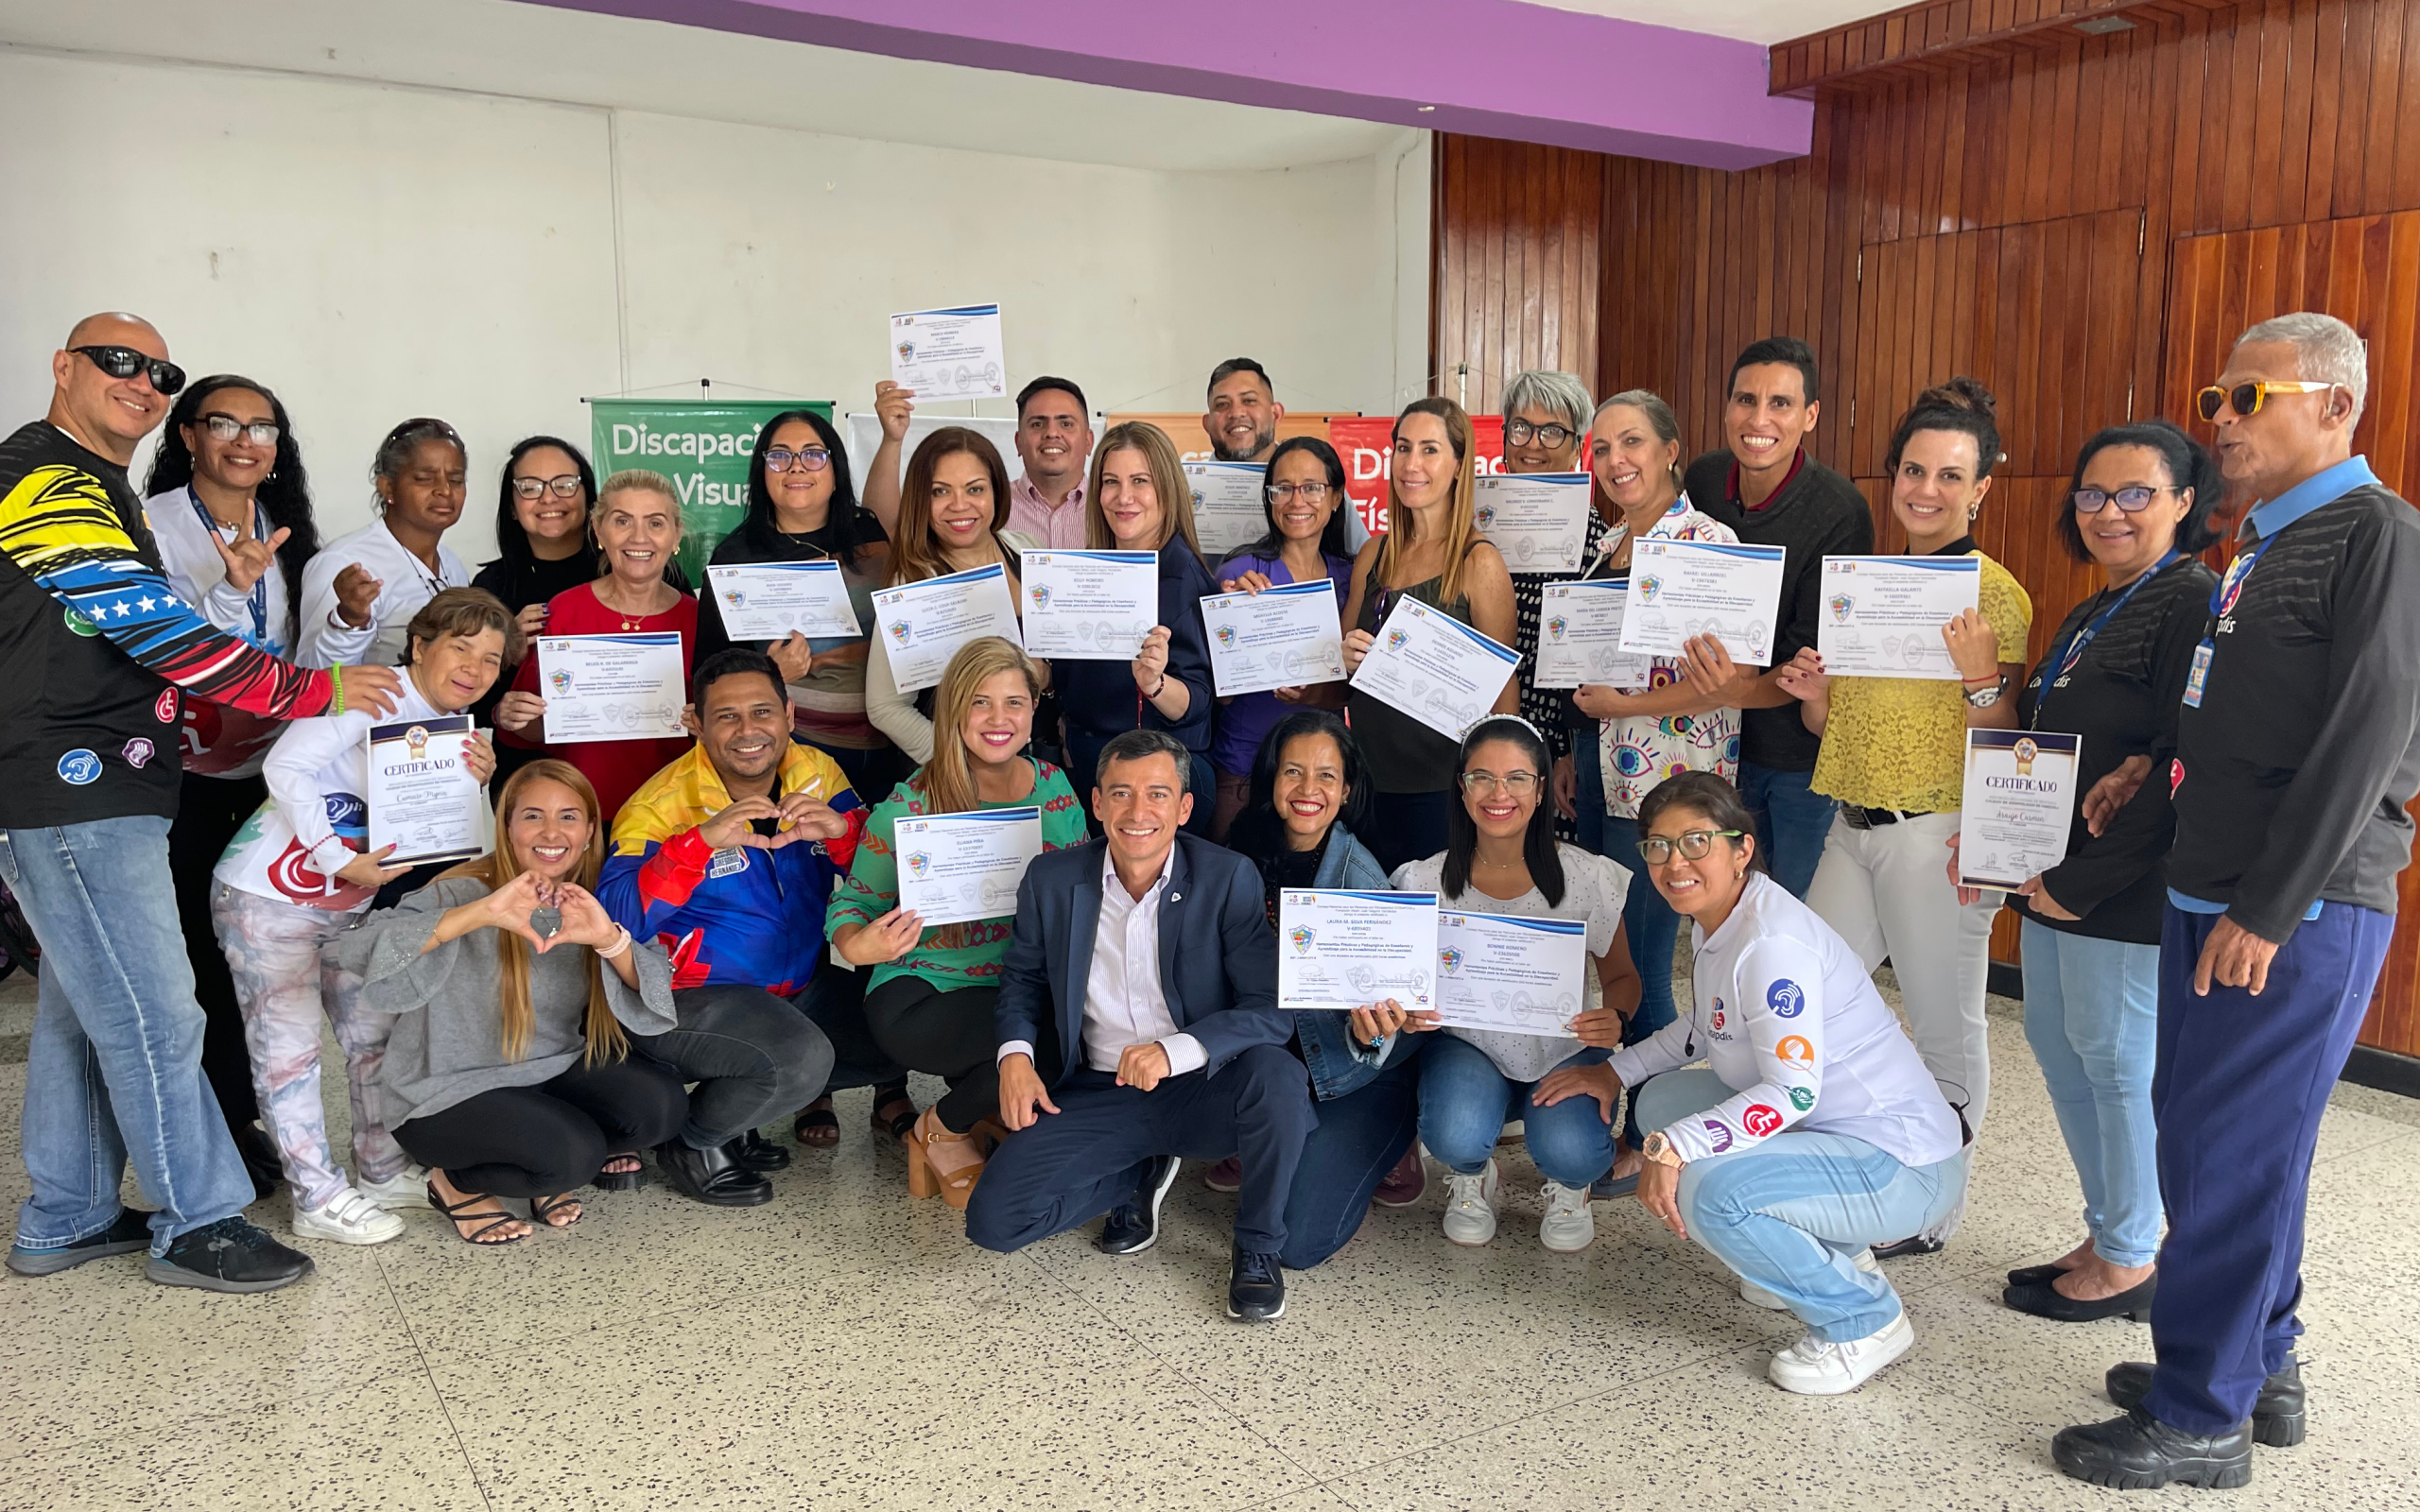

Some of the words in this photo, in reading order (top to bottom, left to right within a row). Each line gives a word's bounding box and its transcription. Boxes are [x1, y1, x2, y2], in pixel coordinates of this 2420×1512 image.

[613, 422, 762, 464] Discapaci
[673, 472, 751, 507] Visua
[1351, 496, 1389, 531] Fís
[2215, 615, 2237, 637] pdis
[2029, 675, 2071, 688] Codis
[384, 758, 455, 776] CERTIFICADO
[1985, 776, 2058, 793] CERTIFICADO
[711, 863, 742, 877] HERNÁNDEZ
[715, 854, 740, 868] GREGORIO
